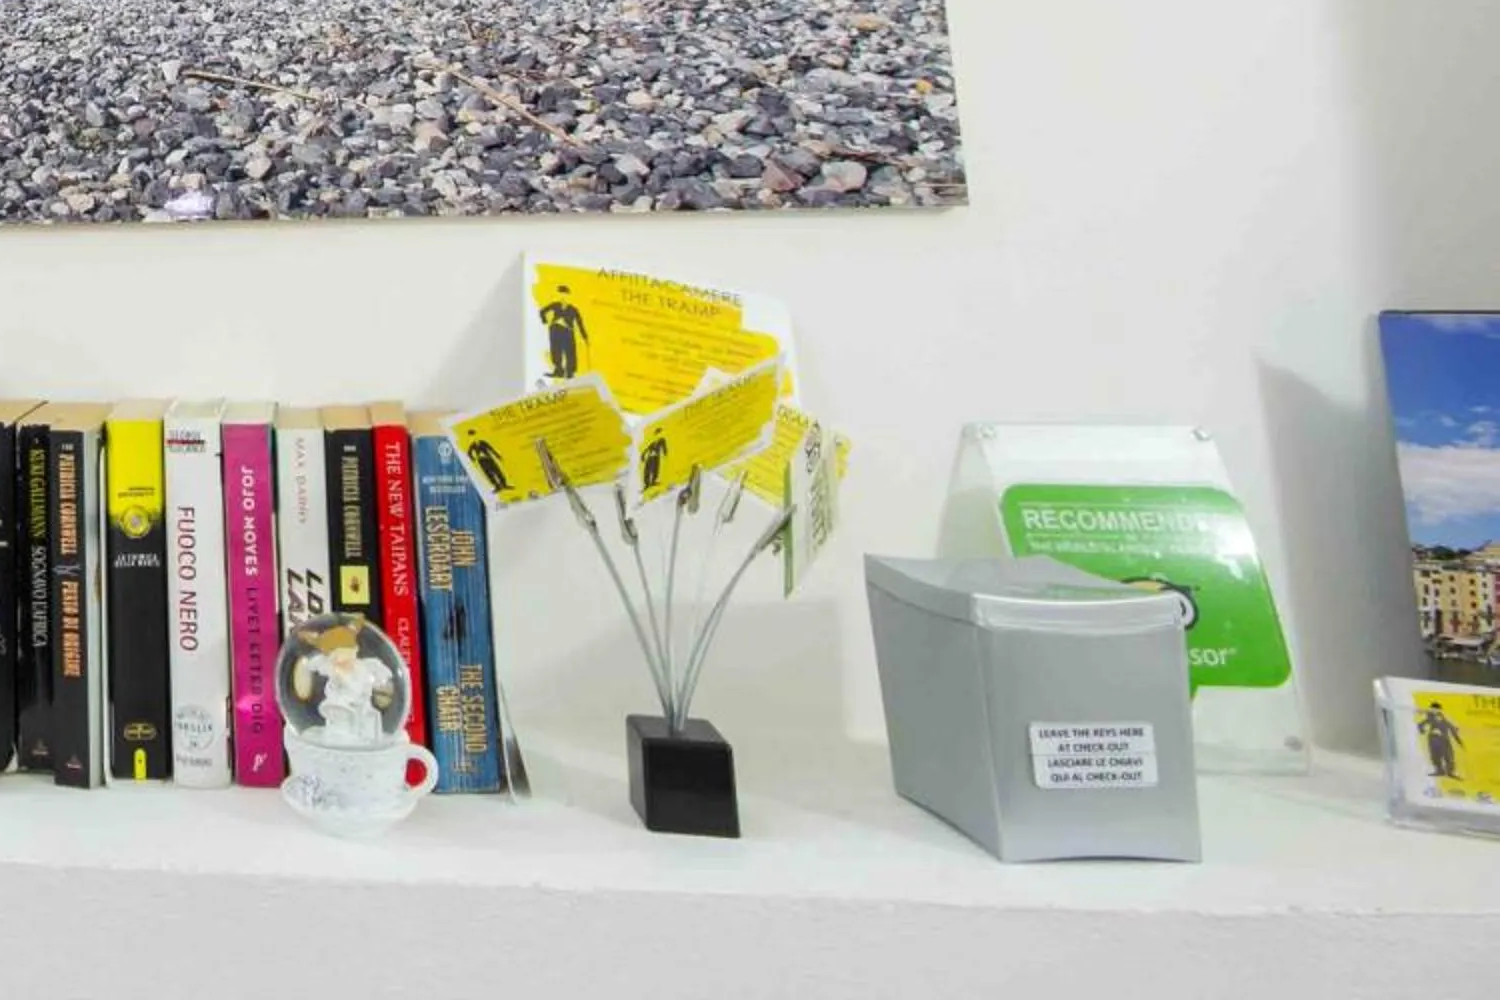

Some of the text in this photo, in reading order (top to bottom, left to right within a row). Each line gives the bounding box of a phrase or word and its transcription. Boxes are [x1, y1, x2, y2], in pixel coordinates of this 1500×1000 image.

[619, 288, 722, 318] THE TRAMP
[489, 389, 568, 421] THE TRAMP
[59, 453, 76, 499] PATRICIA
[385, 441, 402, 475] THE
[240, 465, 255, 511] JOJO
[387, 479, 404, 518] NEW
[59, 501, 77, 554] CORNWELL
[243, 515, 258, 576] MOYES
[425, 505, 453, 592] LESCROART
[451, 529, 477, 566] JOHN
[31, 545, 47, 600] SOGNAVO
[177, 505, 199, 652] FUOCO NERO
[390, 522, 408, 596] TAIPANS
[436, 685, 463, 732] CHAIR
[459, 664, 488, 754] THE SECOND
[1039, 728, 1144, 739] LEAVE THE KEYS HERE
[1058, 743, 1070, 753] AT
[1047, 758, 1143, 769] LASCIARE LE CHIAVI
